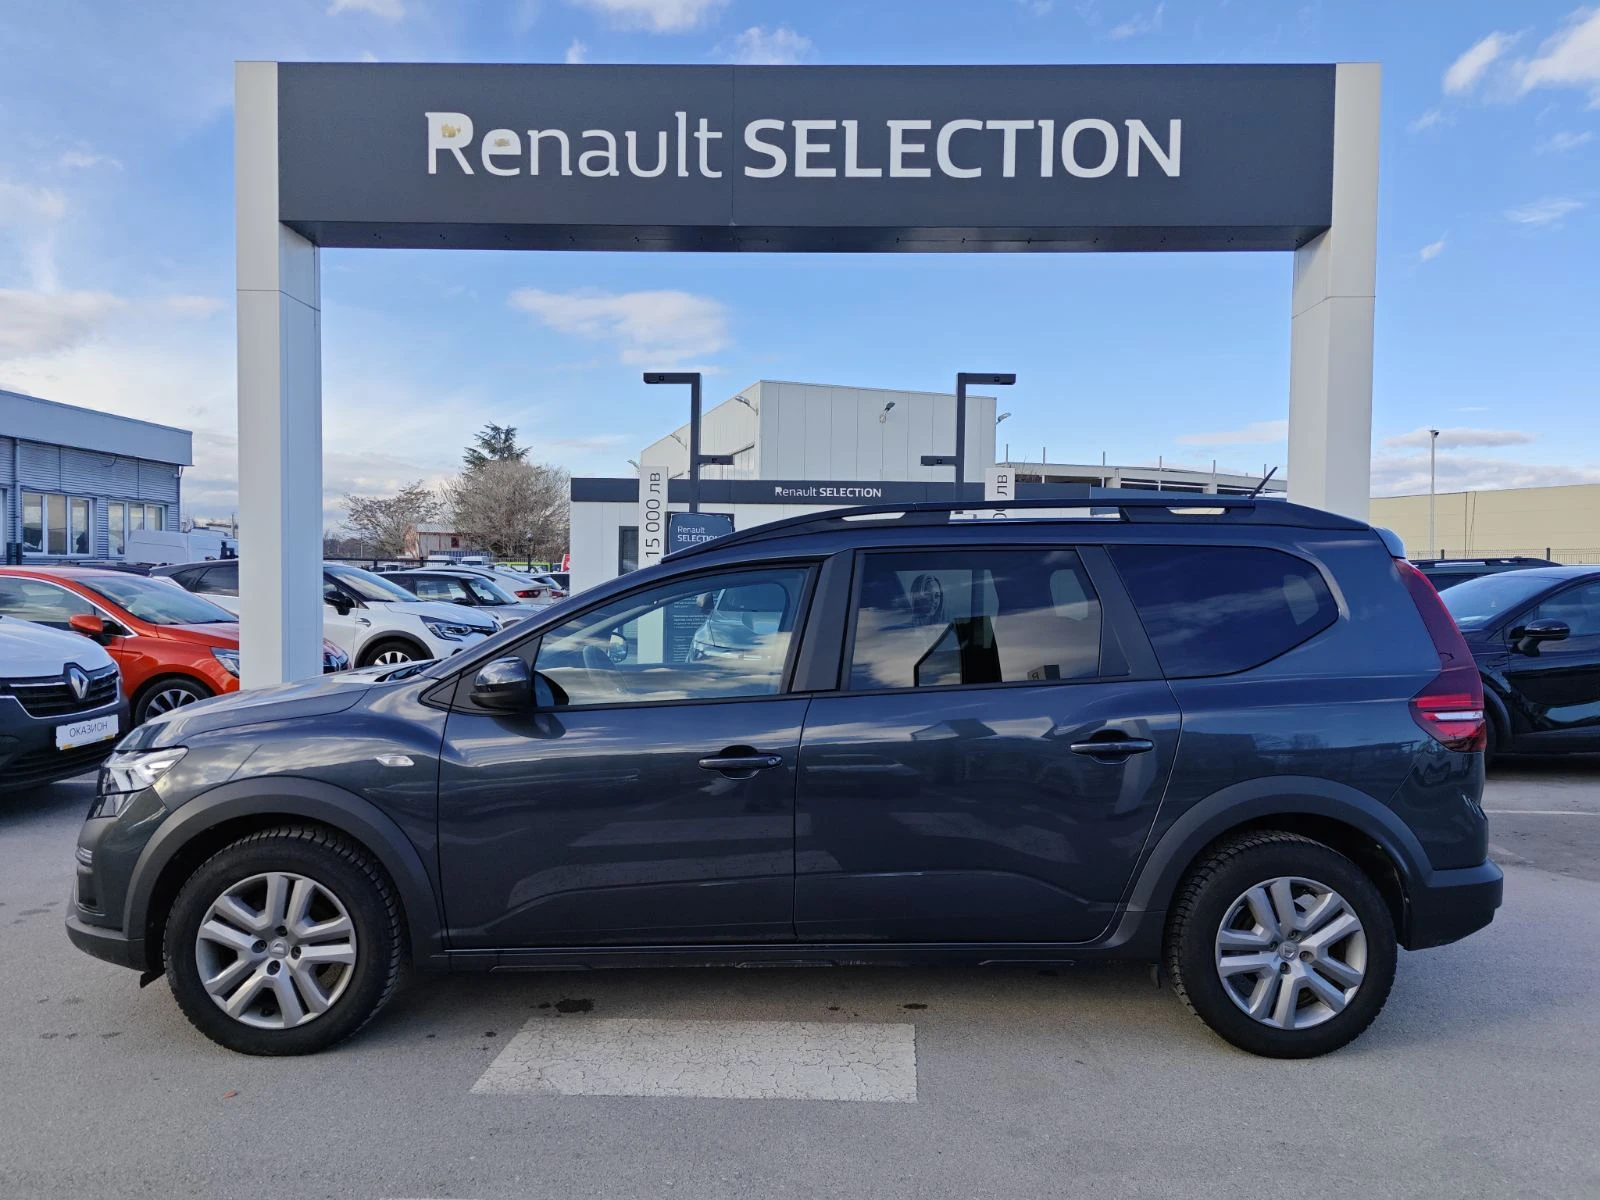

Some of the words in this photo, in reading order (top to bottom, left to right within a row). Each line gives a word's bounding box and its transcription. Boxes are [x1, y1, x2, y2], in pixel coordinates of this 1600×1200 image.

[424, 111, 723, 179] Renault
[743, 118, 1183, 179] SELECTION
[774, 486, 818, 497] Renault
[819, 487, 882, 498] SELECTION
[645, 499, 661, 533] 000
[677, 525, 706, 534] Renault
[645, 538, 660, 557] 15
[69, 722, 108, 738] ОКАЗИОН
